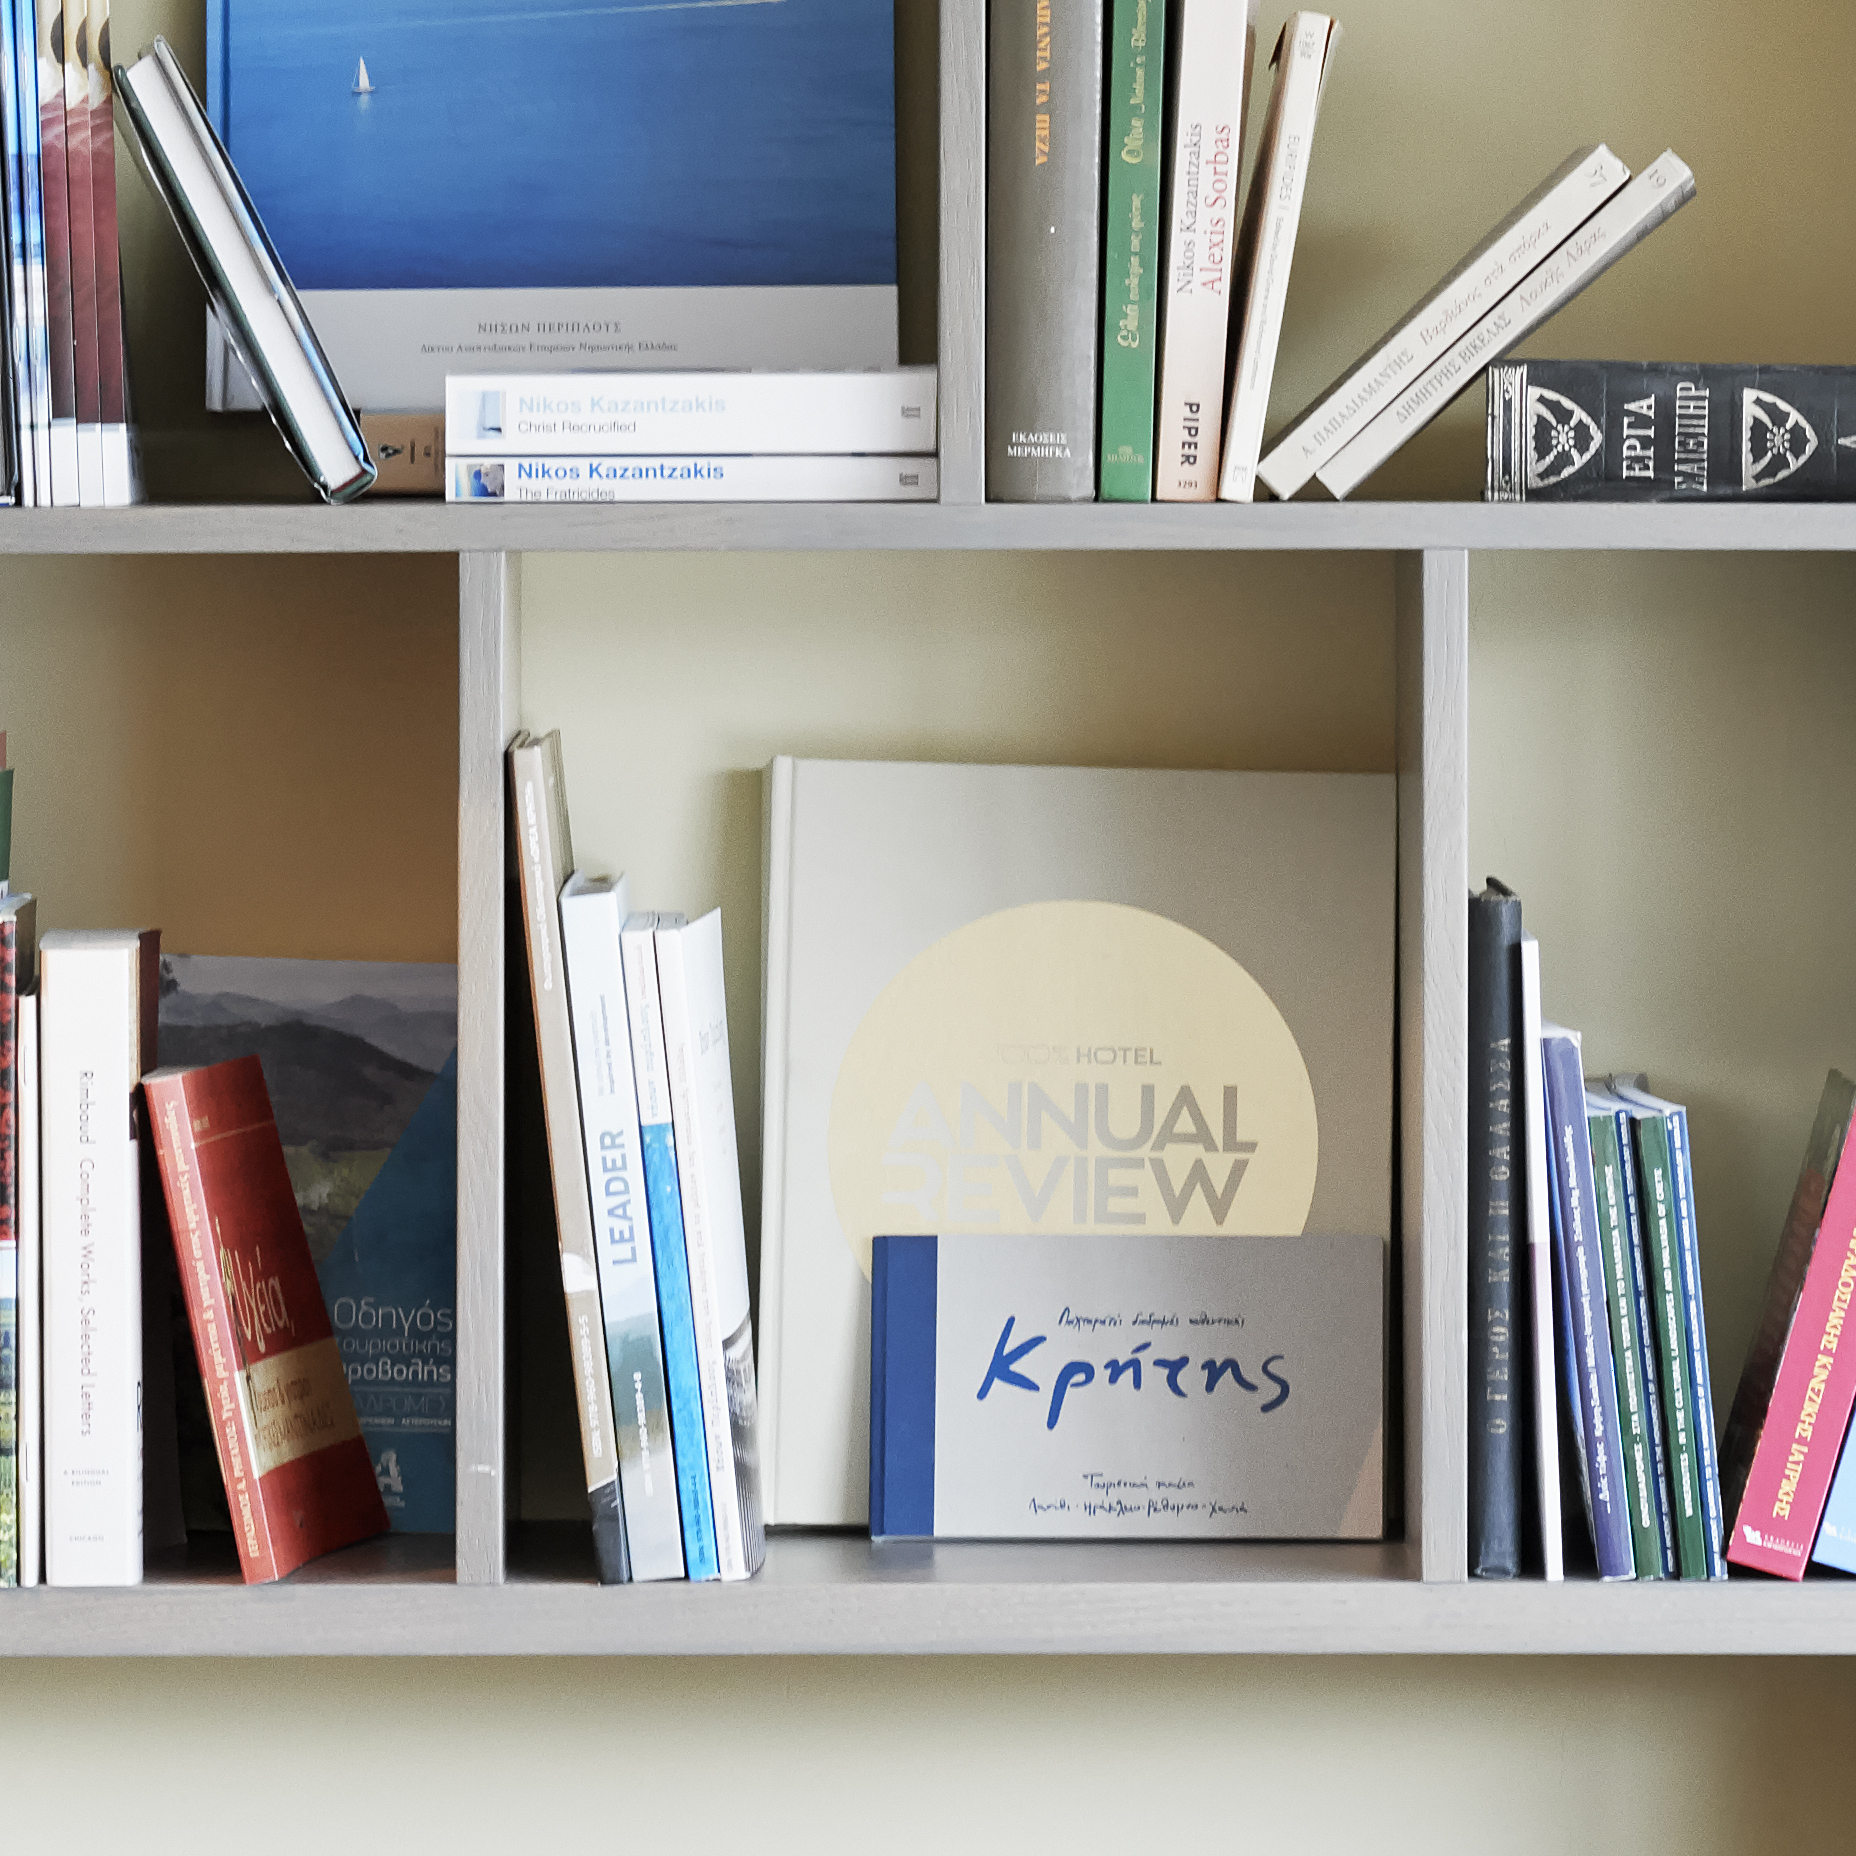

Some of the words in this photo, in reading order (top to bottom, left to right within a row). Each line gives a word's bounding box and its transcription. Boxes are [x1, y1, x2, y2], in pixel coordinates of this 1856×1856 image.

[1035, 81, 1051, 106] ΤΑ
[1035, 113, 1051, 167] ΠΕΖΑ
[1203, 124, 1231, 210] Sorbas
[1179, 122, 1203, 234] Kazantzakis
[1176, 239, 1197, 295] Nikos
[1199, 216, 1227, 296] Alexis
[477, 322, 531, 334] ΝΗΣΩΝ
[1315, 347, 1414, 446] ΠΑΠΑΔΙΑΜΑΝΤΗΣ
[1395, 359, 1462, 425] ΔΗΜΗΤΡΗΣ
[1460, 310, 1512, 366] ΒΙΚΕΛΑΣ
[517, 419, 557, 435] Christ
[561, 419, 637, 435] Recrucified
[518, 395, 582, 415] Nikos
[590, 394, 727, 415] Kazantzakis
[1180, 401, 1201, 468] PIPER
[1621, 394, 1658, 480] ΕΡΓΑ
[1674, 380, 1711, 492] ΣΑΙΞΠΗΡ
[517, 461, 581, 481] Nikos
[589, 460, 725, 481] Kazantzakis
[517, 487, 542, 501] The
[545, 487, 616, 501] Fratricides
[1075, 1047, 1163, 1067] HOTEL
[77, 1069, 96, 1145] Rimbaud
[886, 1081, 1259, 1154] ANNUAL
[1488, 1037, 1512, 1182] ΘΑΛΑΣΣΑ
[75, 1158, 96, 1237] Complete
[598, 1128, 639, 1266] LEADER
[881, 1153, 1251, 1227] REVIEW
[1487, 1199, 1509, 1217] Η
[76, 1241, 95, 1302] Works,
[1487, 1232, 1511, 1283] ΚΑΙ
[79, 1306, 97, 1377] Selected
[333, 1295, 453, 1337] Οδηγός
[976, 1315, 1292, 1431] Κρήτης
[1486, 1306, 1510, 1403] ΓΕΡΟΣ
[79, 1382, 96, 1438] Letters
[1487, 1418, 1508, 1435] Ο
[1794, 1352, 1833, 1442] ΚΙΝΕΖΙΚΗΣ
[1771, 1442, 1808, 1522] ΙΑΤΡΙΚΗΣ
